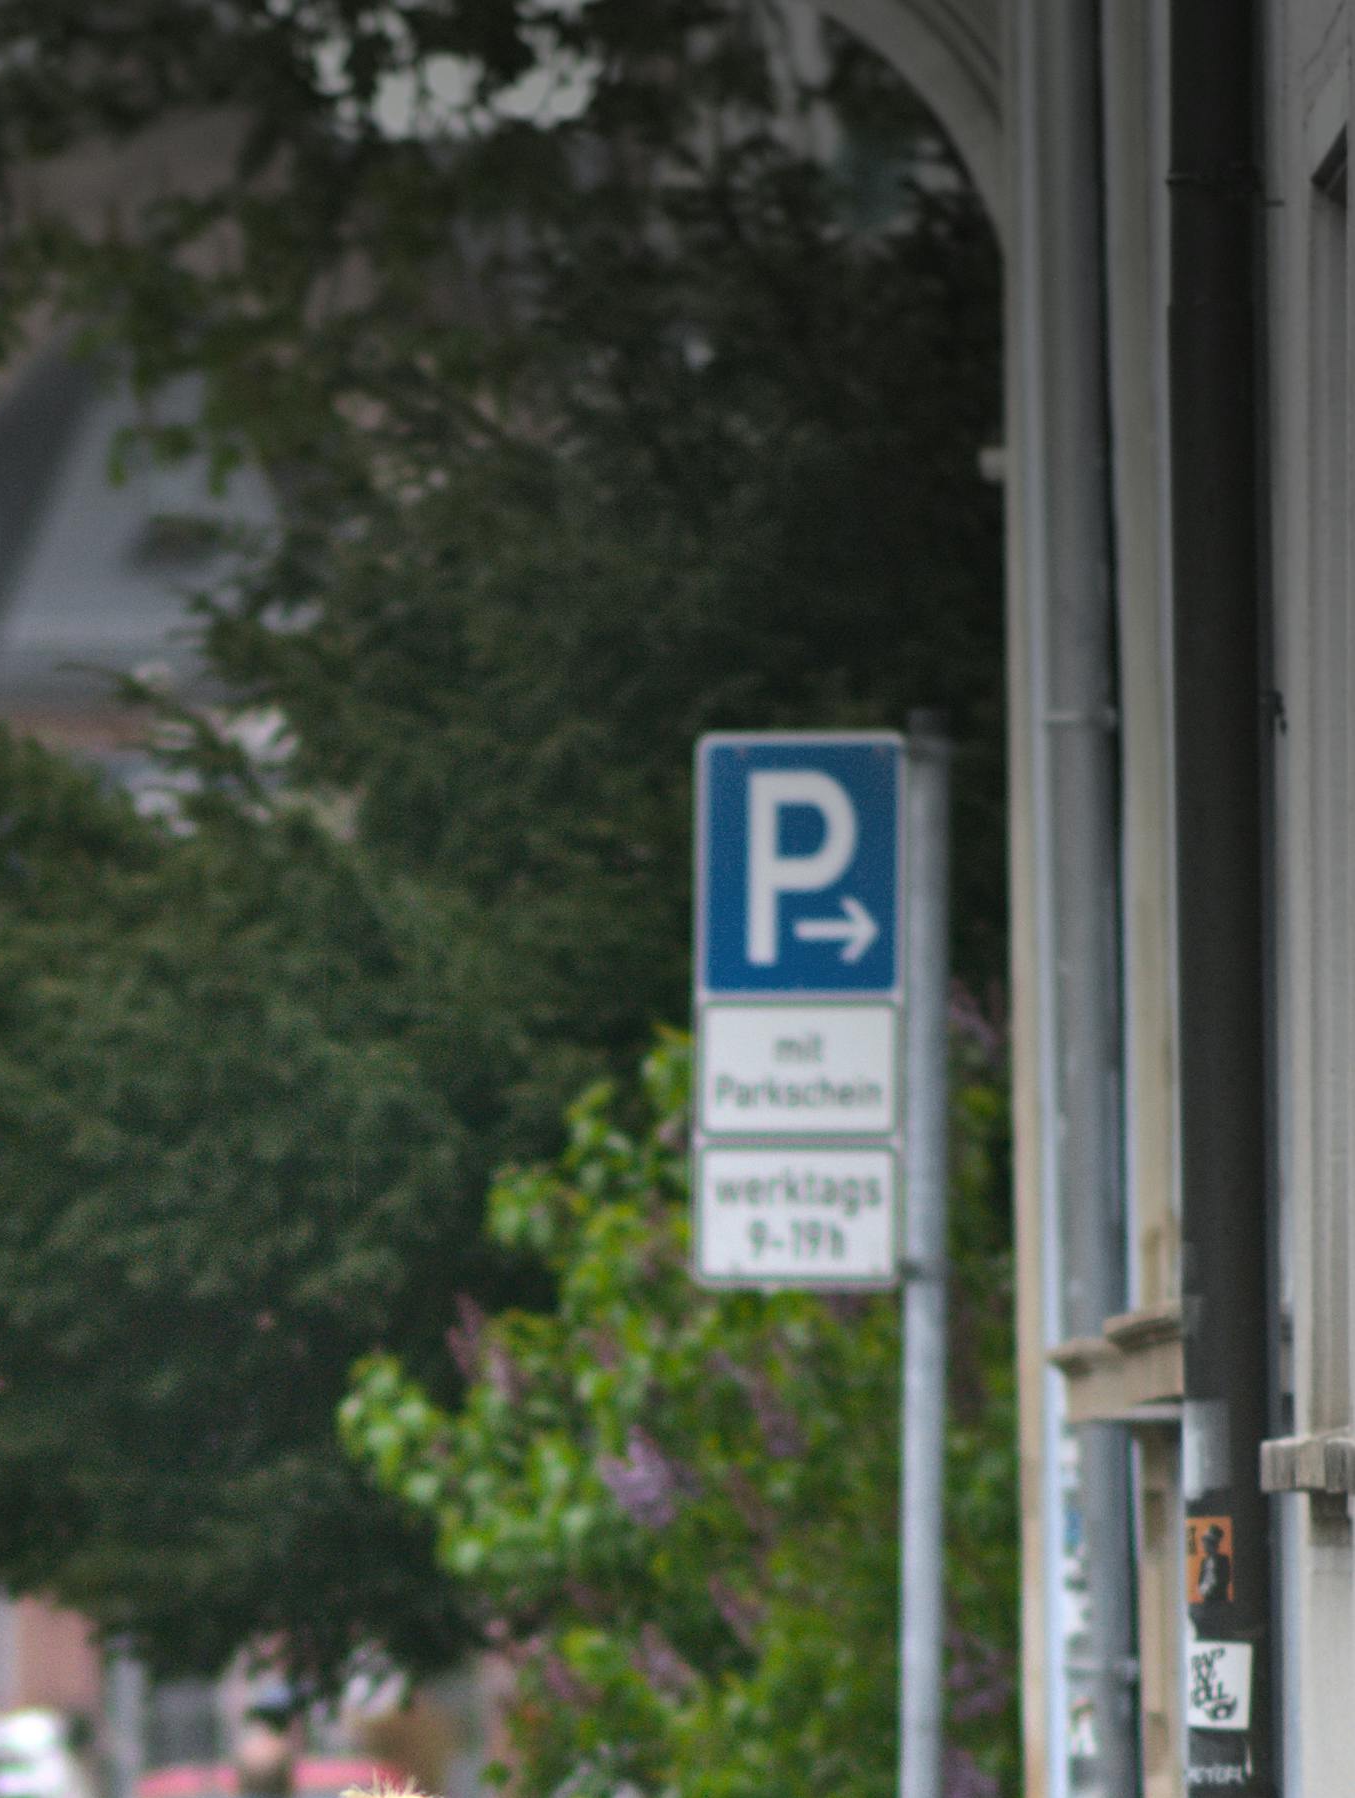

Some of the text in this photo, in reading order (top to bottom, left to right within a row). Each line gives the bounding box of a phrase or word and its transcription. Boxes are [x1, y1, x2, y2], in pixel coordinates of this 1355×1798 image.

[747, 769, 859, 967] P
[715, 1073, 883, 1108] Parkschein
[715, 1168, 883, 1217] werktags
